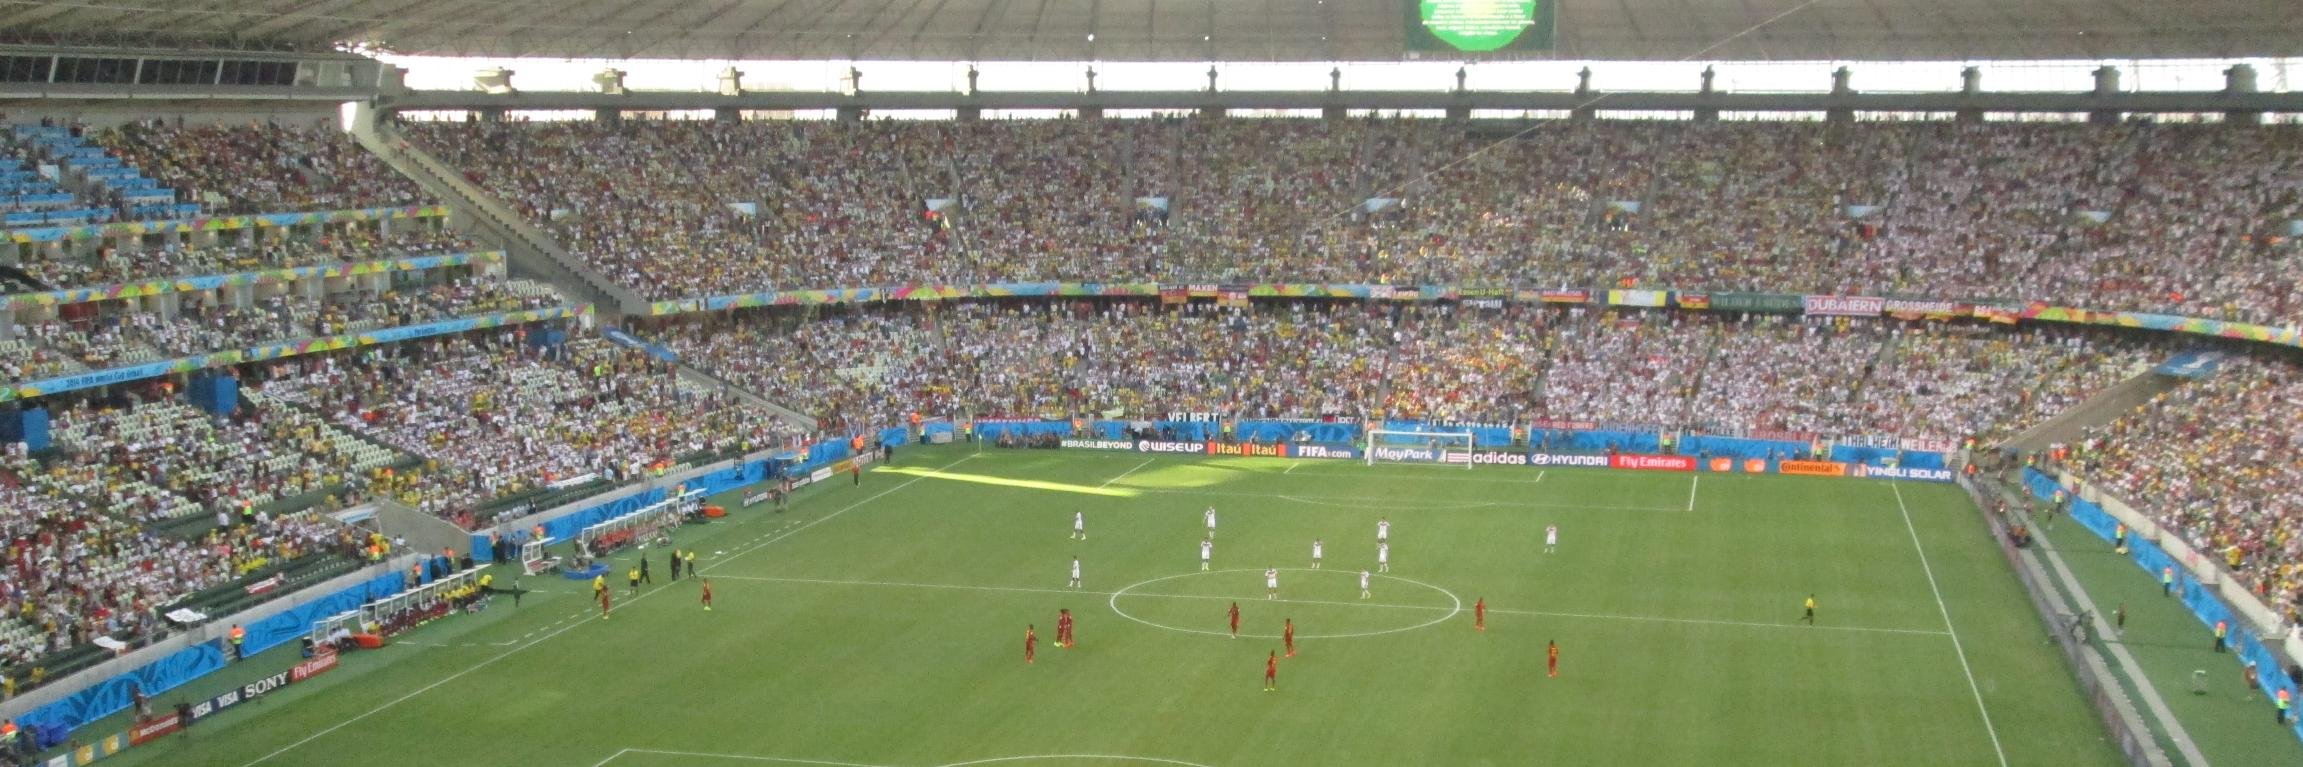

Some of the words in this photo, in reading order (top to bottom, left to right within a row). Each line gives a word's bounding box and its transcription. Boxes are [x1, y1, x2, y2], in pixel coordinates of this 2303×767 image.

[1061, 440, 1132, 450] #BRASILBEYOND
[1217, 443, 1242, 455] Itaú
[1251, 444, 1277, 456] Itaú
[1298, 445, 1351, 459] FIFA.com
[1473, 452, 1526, 465] adidas
[1552, 454, 1608, 466] HYUNDAI
[1620, 457, 1639, 468] Fly
[1640, 457, 1687, 468] Emirates
[1910, 468, 1952, 479] SOLAR
[244, 671, 288, 699] SONY
[216, 690, 239, 708] VISA
[192, 701, 212, 718] VISA
